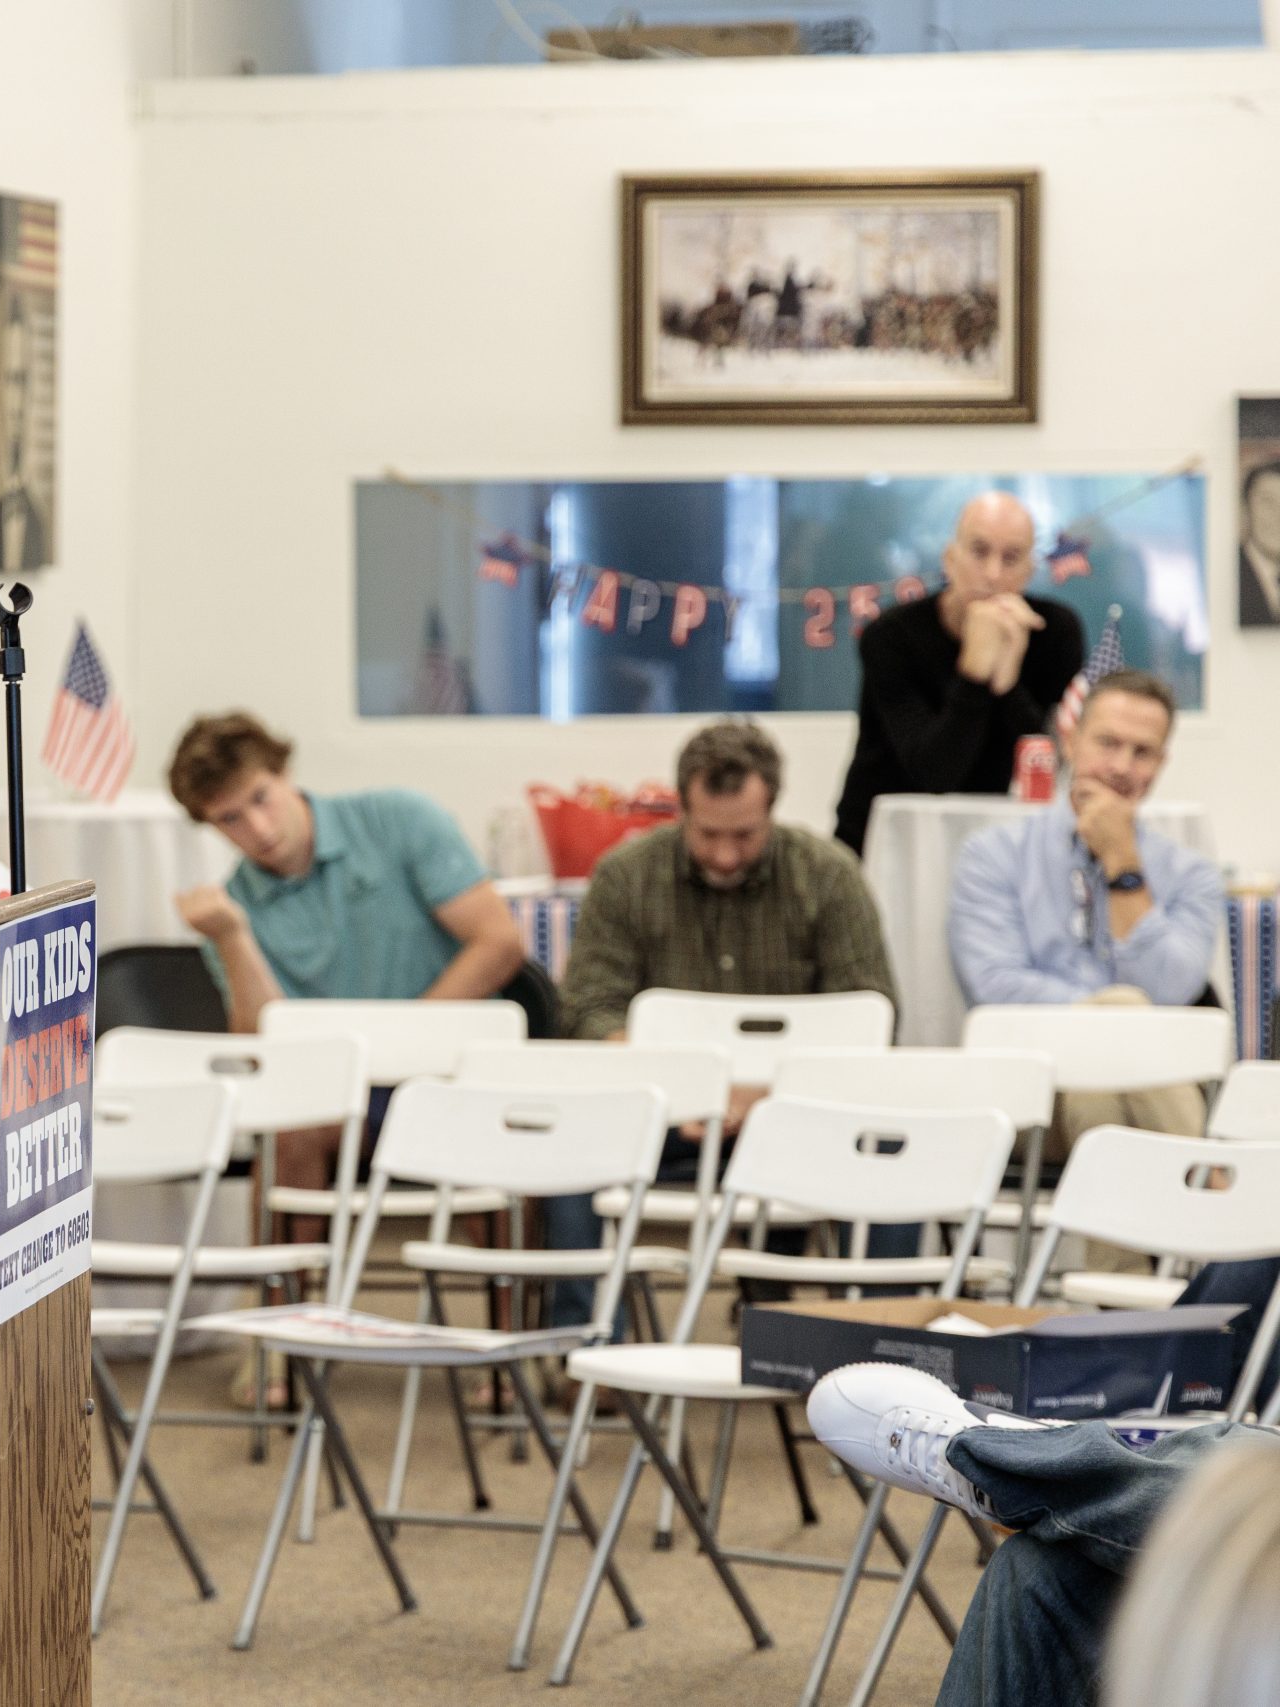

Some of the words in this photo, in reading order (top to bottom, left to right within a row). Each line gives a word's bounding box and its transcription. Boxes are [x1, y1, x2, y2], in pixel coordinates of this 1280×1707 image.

[1, 938, 39, 1023] OUR
[43, 920, 92, 1005] KIDS
[0, 1013, 89, 1121] DESERVE
[6, 1101, 83, 1209] BETTER
[21, 1230, 54, 1277] CHANGE
[55, 1223, 66, 1256] TO
[67, 1209, 90, 1250] 60503
